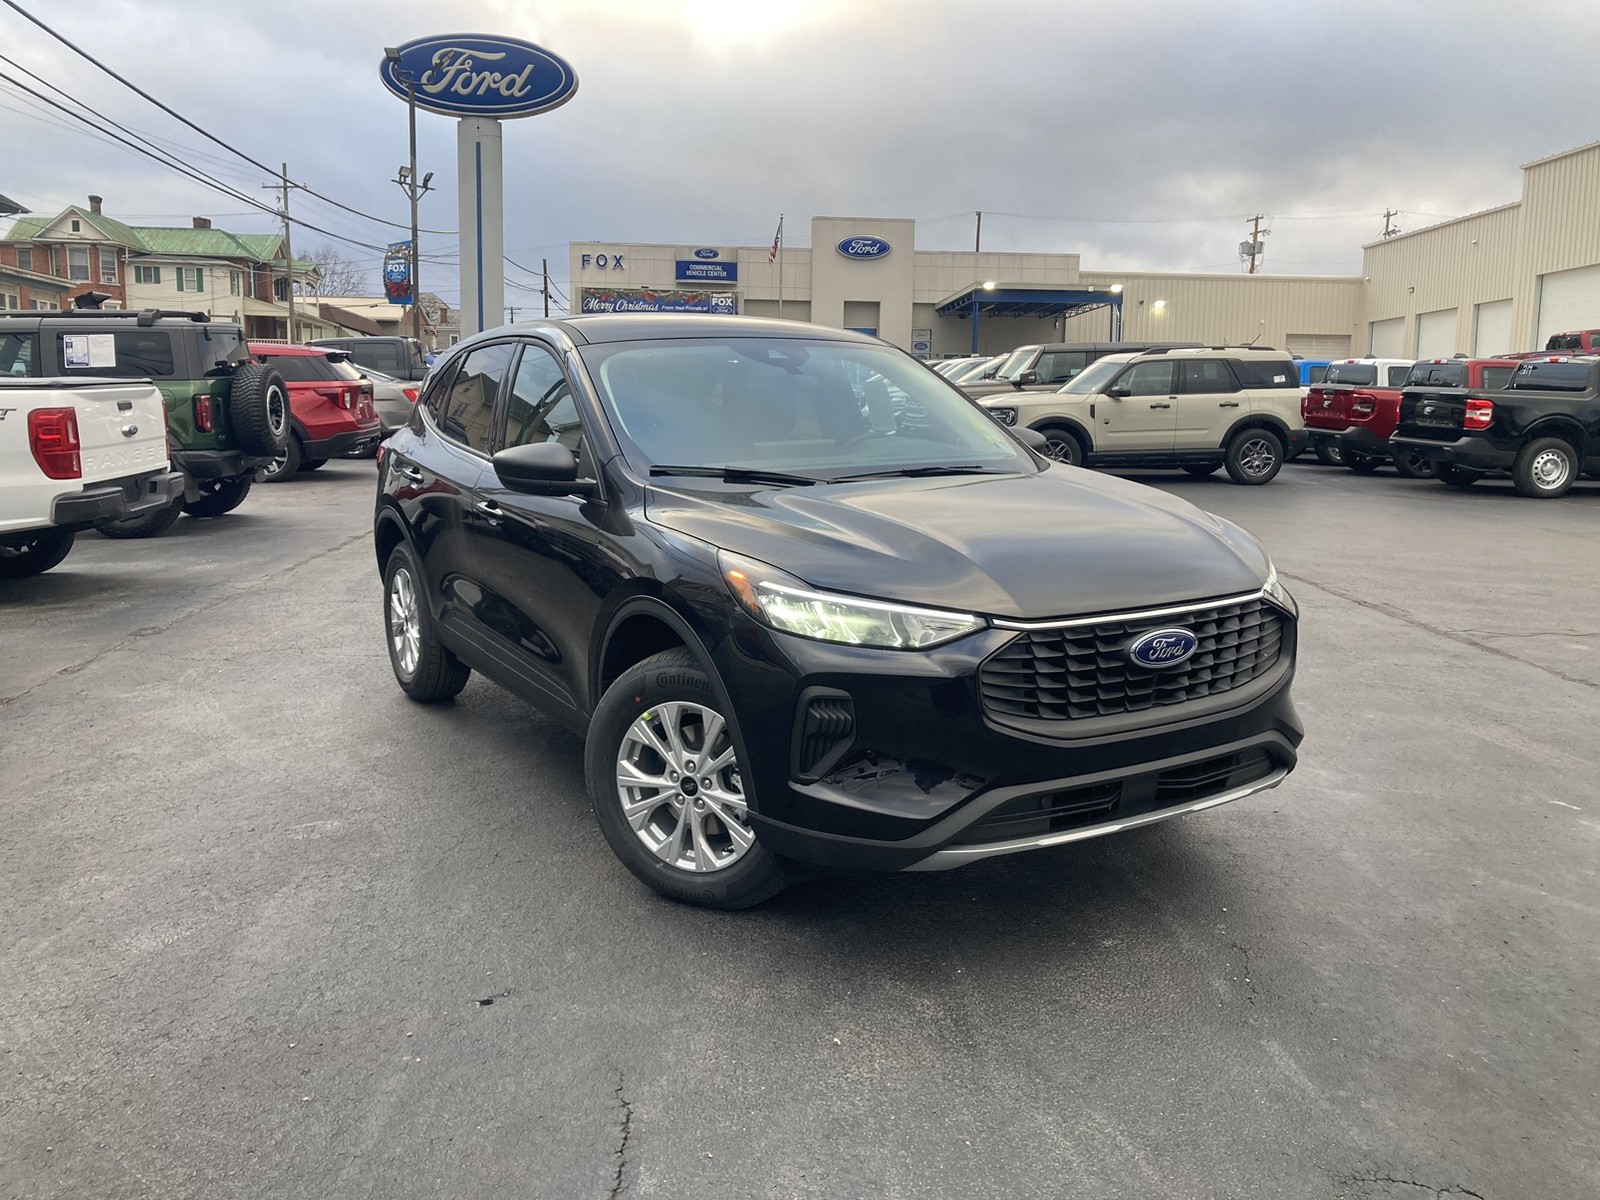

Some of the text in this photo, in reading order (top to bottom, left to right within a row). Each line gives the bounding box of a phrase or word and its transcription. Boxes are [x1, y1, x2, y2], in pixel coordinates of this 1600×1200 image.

[421, 47, 535, 97] Ford
[698, 249, 715, 257] Ford
[849, 240, 880, 253] Ford
[387, 264, 405, 272] FOX
[581, 254, 624, 269] FOX
[583, 298, 614, 313] Merry
[616, 299, 659, 311] Christmas
[712, 298, 733, 306] FOX
[1149, 637, 1185, 660] Ford
[656, 672, 713, 691] Continen
